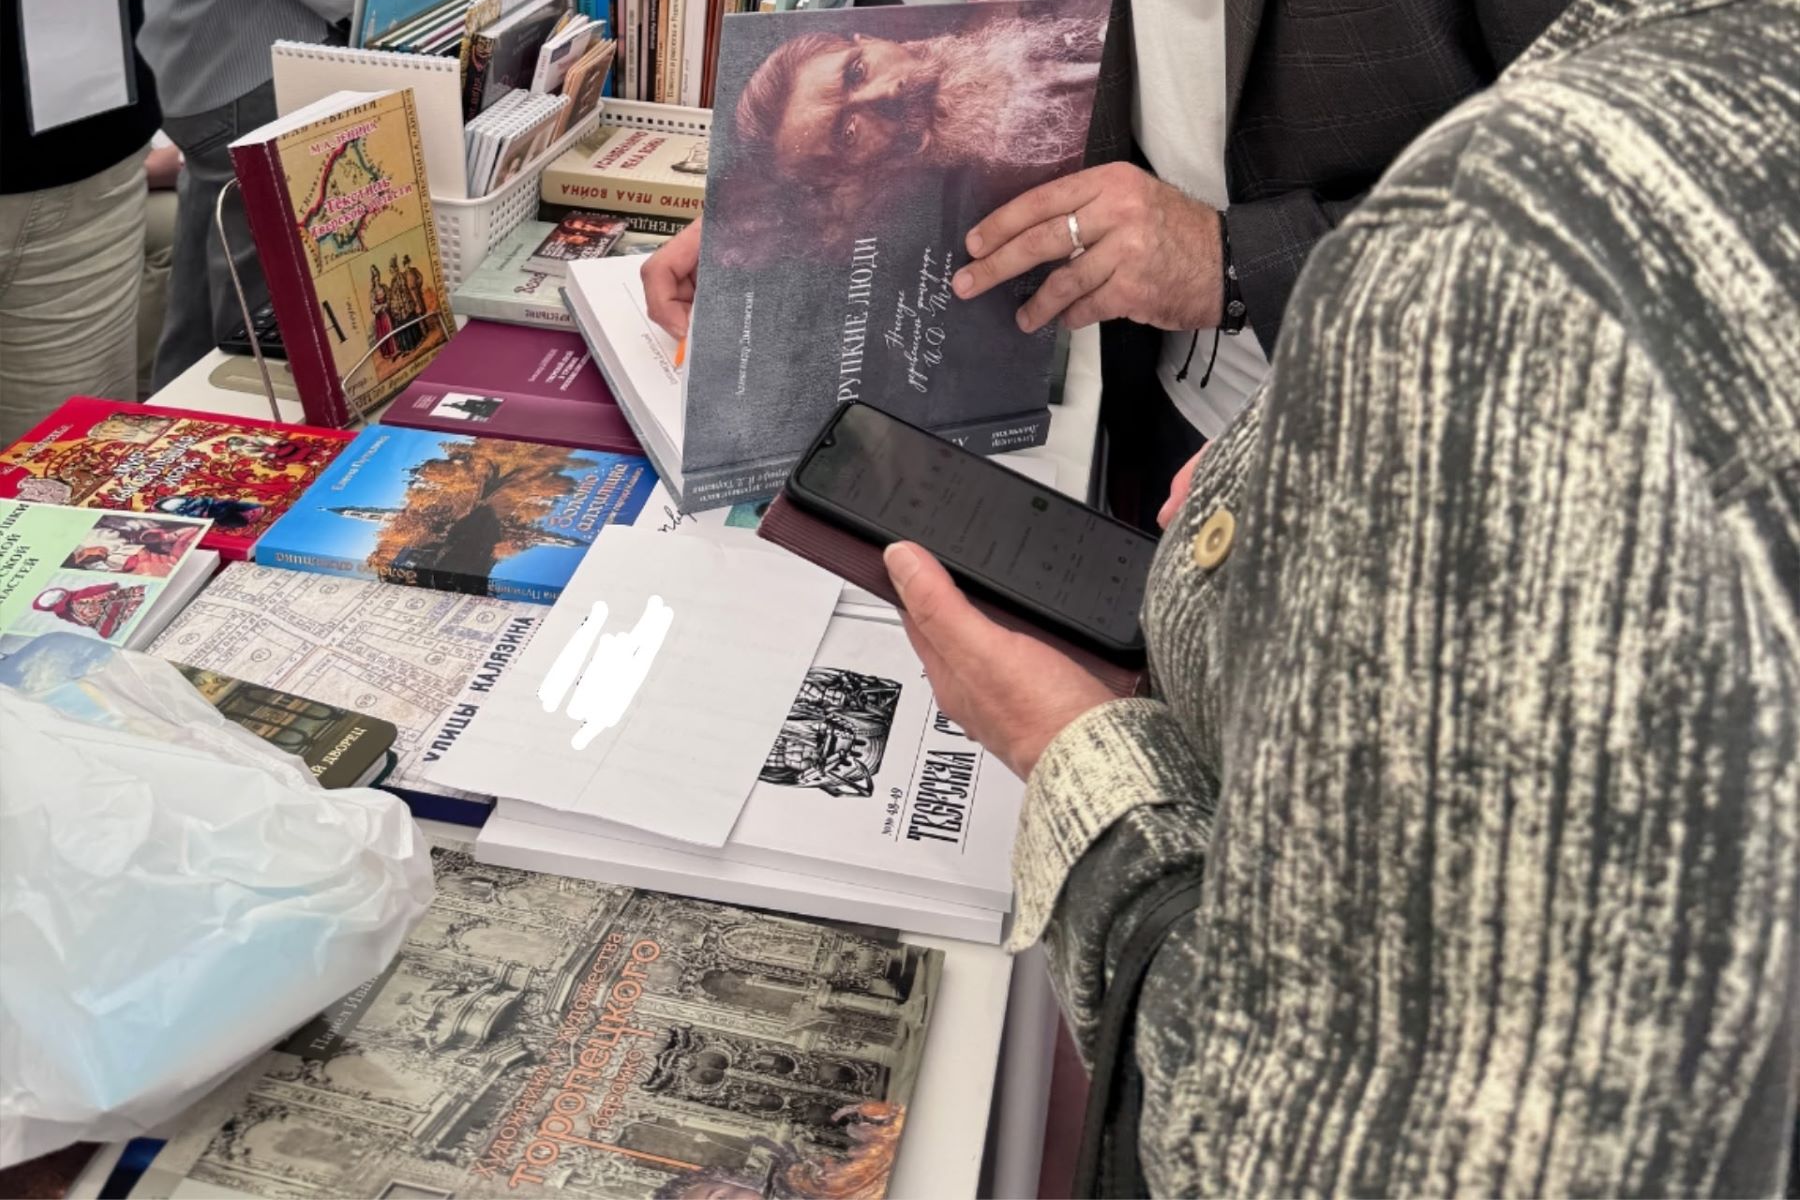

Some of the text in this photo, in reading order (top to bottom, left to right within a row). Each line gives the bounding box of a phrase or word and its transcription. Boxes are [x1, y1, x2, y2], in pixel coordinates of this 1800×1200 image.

[561, 183, 607, 200] ВОЙНА
[616, 190, 653, 205] ПЕЛА
[837, 236, 878, 403] РУПКИЕ ЛЮДИ
[423, 702, 480, 764] УЛИЦЫ
[473, 615, 536, 694] КАЛЯЗИНА
[320, 727, 367, 767] ДВОРЕЦ
[906, 749, 977, 844] ТВЕРСКАЯ
[472, 1066, 553, 1178] художники
[559, 931, 624, 1043] художества
[509, 939, 703, 1189] торопецкого
[592, 1047, 645, 1131] барокко
